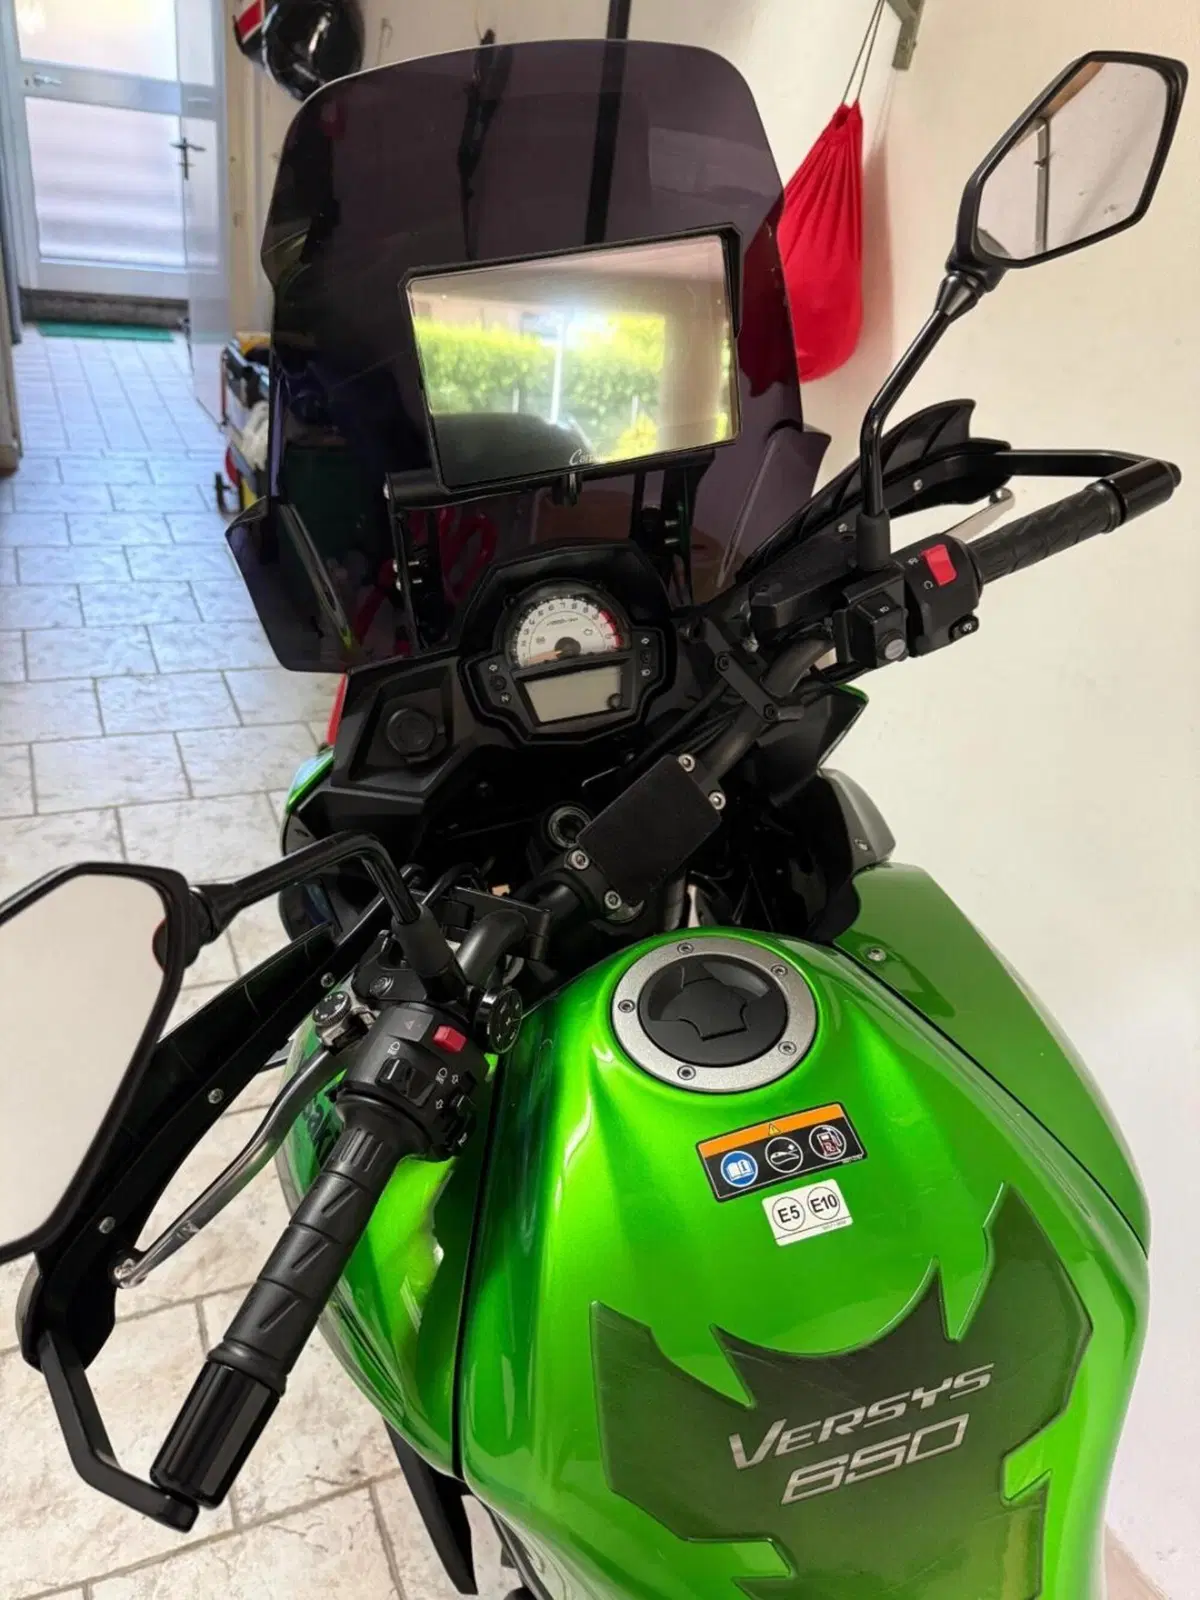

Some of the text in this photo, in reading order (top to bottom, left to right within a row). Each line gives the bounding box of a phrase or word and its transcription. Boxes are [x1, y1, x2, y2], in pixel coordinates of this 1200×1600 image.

[777, 1194, 838, 1224] E5 E10
[728, 1363, 995, 1470] VERSYS
[781, 1413, 970, 1505] 650
